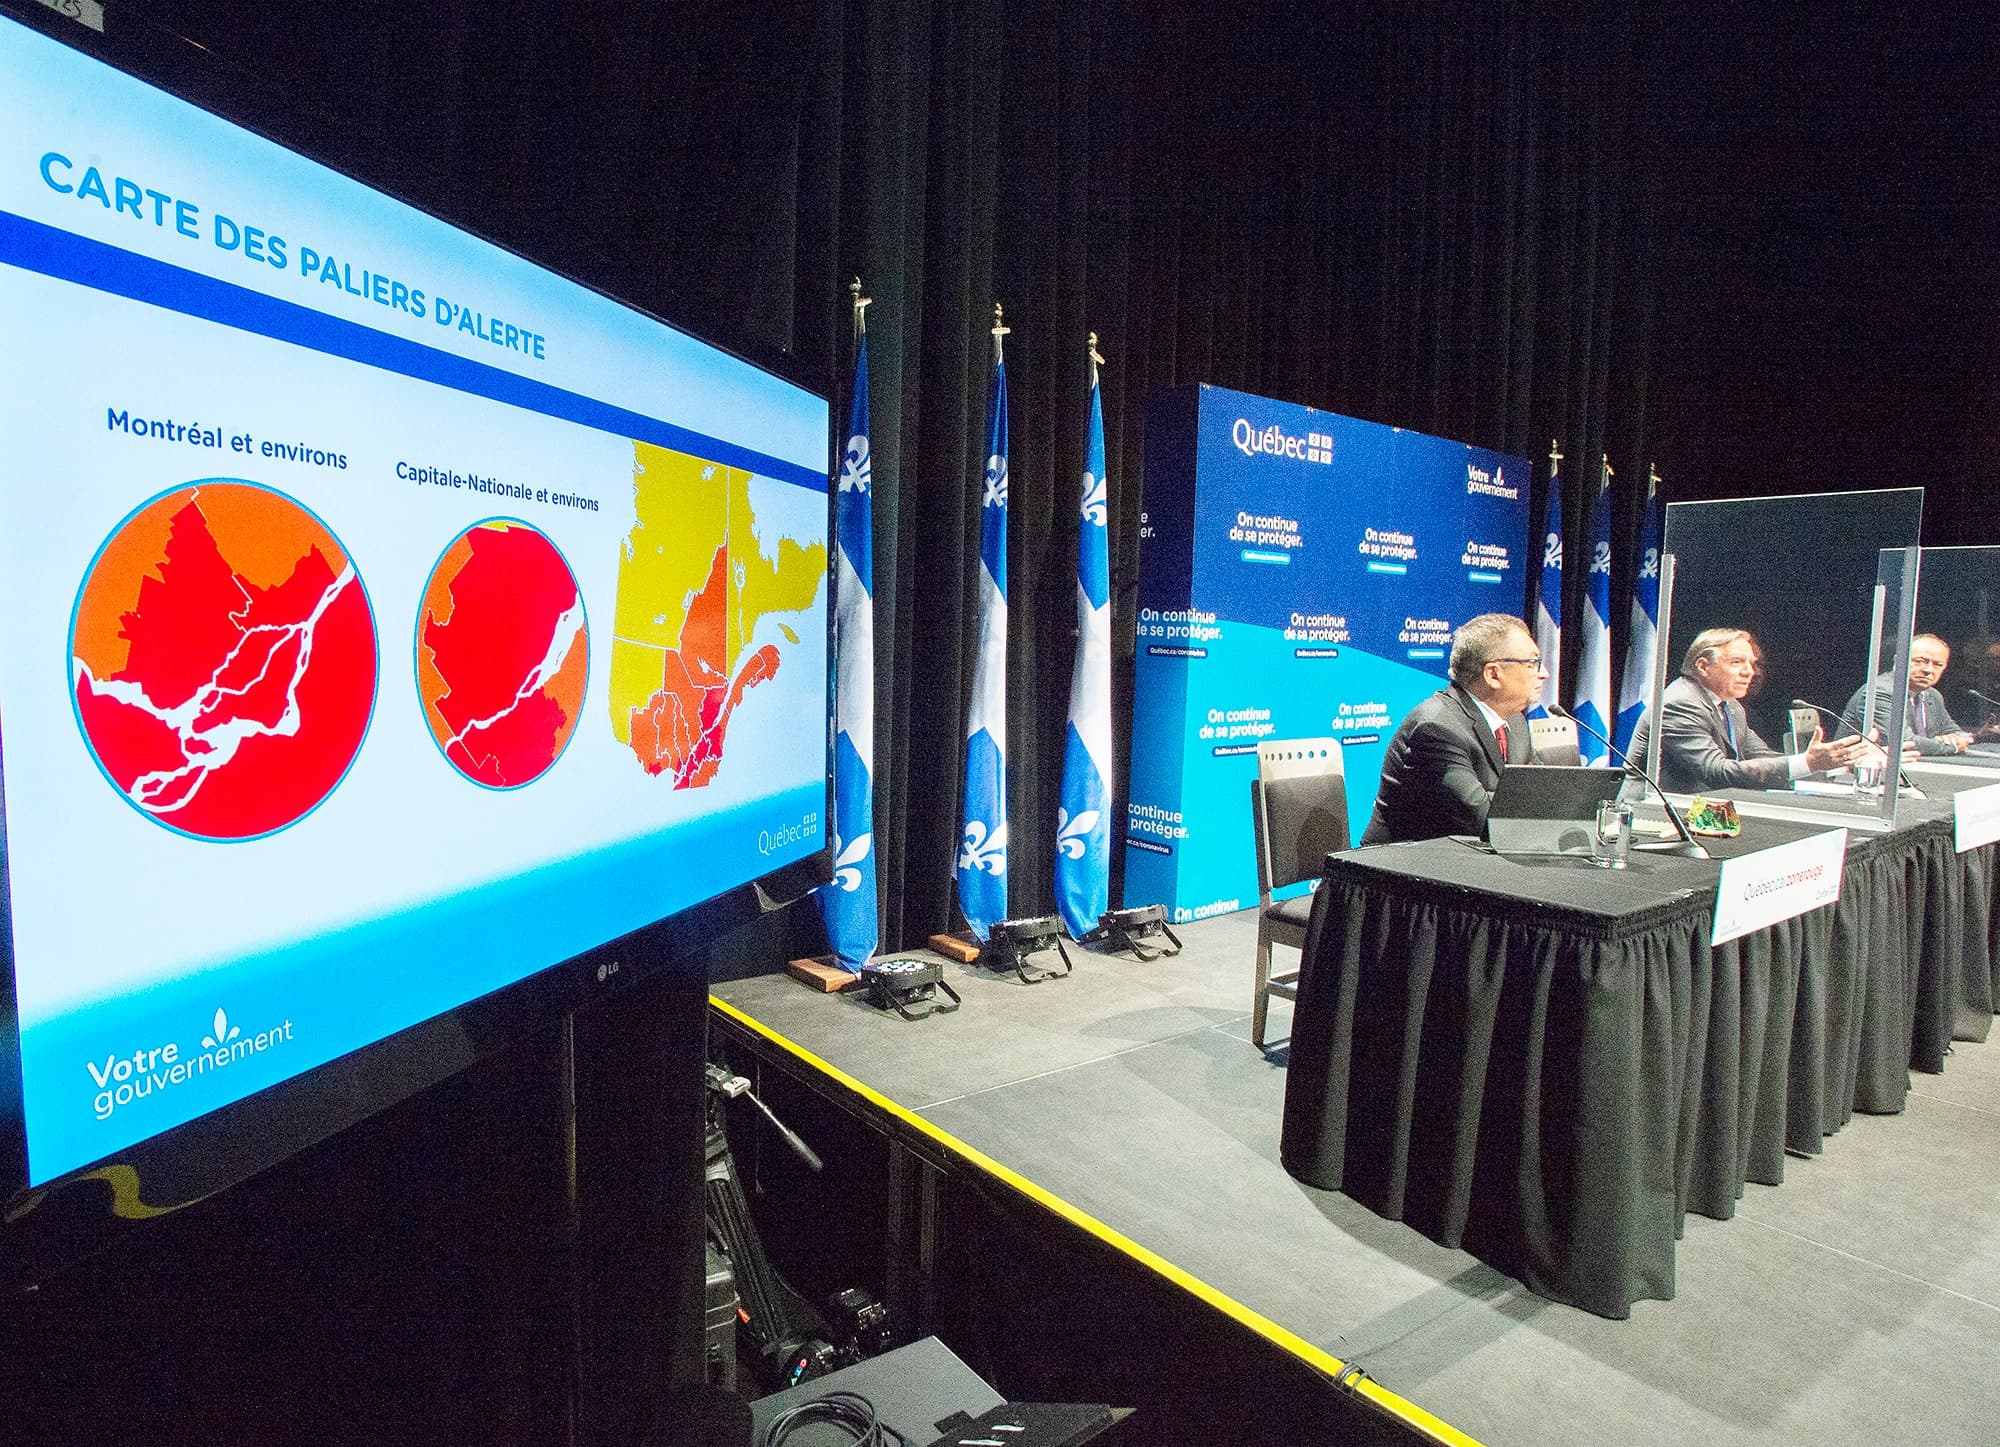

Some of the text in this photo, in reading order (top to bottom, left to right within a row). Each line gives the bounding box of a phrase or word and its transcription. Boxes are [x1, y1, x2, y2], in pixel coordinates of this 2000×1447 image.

[39, 151, 546, 361] CARTE DES PALIERS D’ALERTE
[107, 407, 348, 470] Montréal et environs
[1232, 418, 1307, 460] Québec
[1468, 465, 1489, 483] Votre
[396, 461, 600, 512] Capitale-Nationale et environs
[1468, 481, 1518, 499] gouvernement
[1238, 512, 1297, 532] On continue
[1230, 527, 1303, 548] de se protéger.
[1365, 528, 1414, 546] On continue
[1359, 541, 1417, 560] de se protéger.
[1468, 541, 1507, 557] On continue
[1462, 553, 1510, 570] de se protéger.
[1142, 608, 1215, 624] On continue
[1291, 613, 1346, 627] On continue
[1405, 617, 1449, 630] On continue
[1150, 625, 1164, 636] se
[1167, 625, 1223, 641] protéger.
[1284, 627, 1350, 643] de se protéger.
[1399, 630, 1453, 645] de se protéger.
[1208, 708, 1271, 723] On continue
[1340, 702, 1387, 715] On continue
[1200, 721, 1276, 739] de se protéger.
[1332, 715, 1392, 730] de se protéger.
[1128, 804, 1183, 824] continue
[1131, 817, 1190, 839] protéger.
[758, 823, 803, 857] Québec
[1175, 898, 1240, 922] On continue
[608, 961, 620, 975] LG
[86, 1042, 179, 1089] Votre
[93, 1018, 295, 1121] gouvernement
